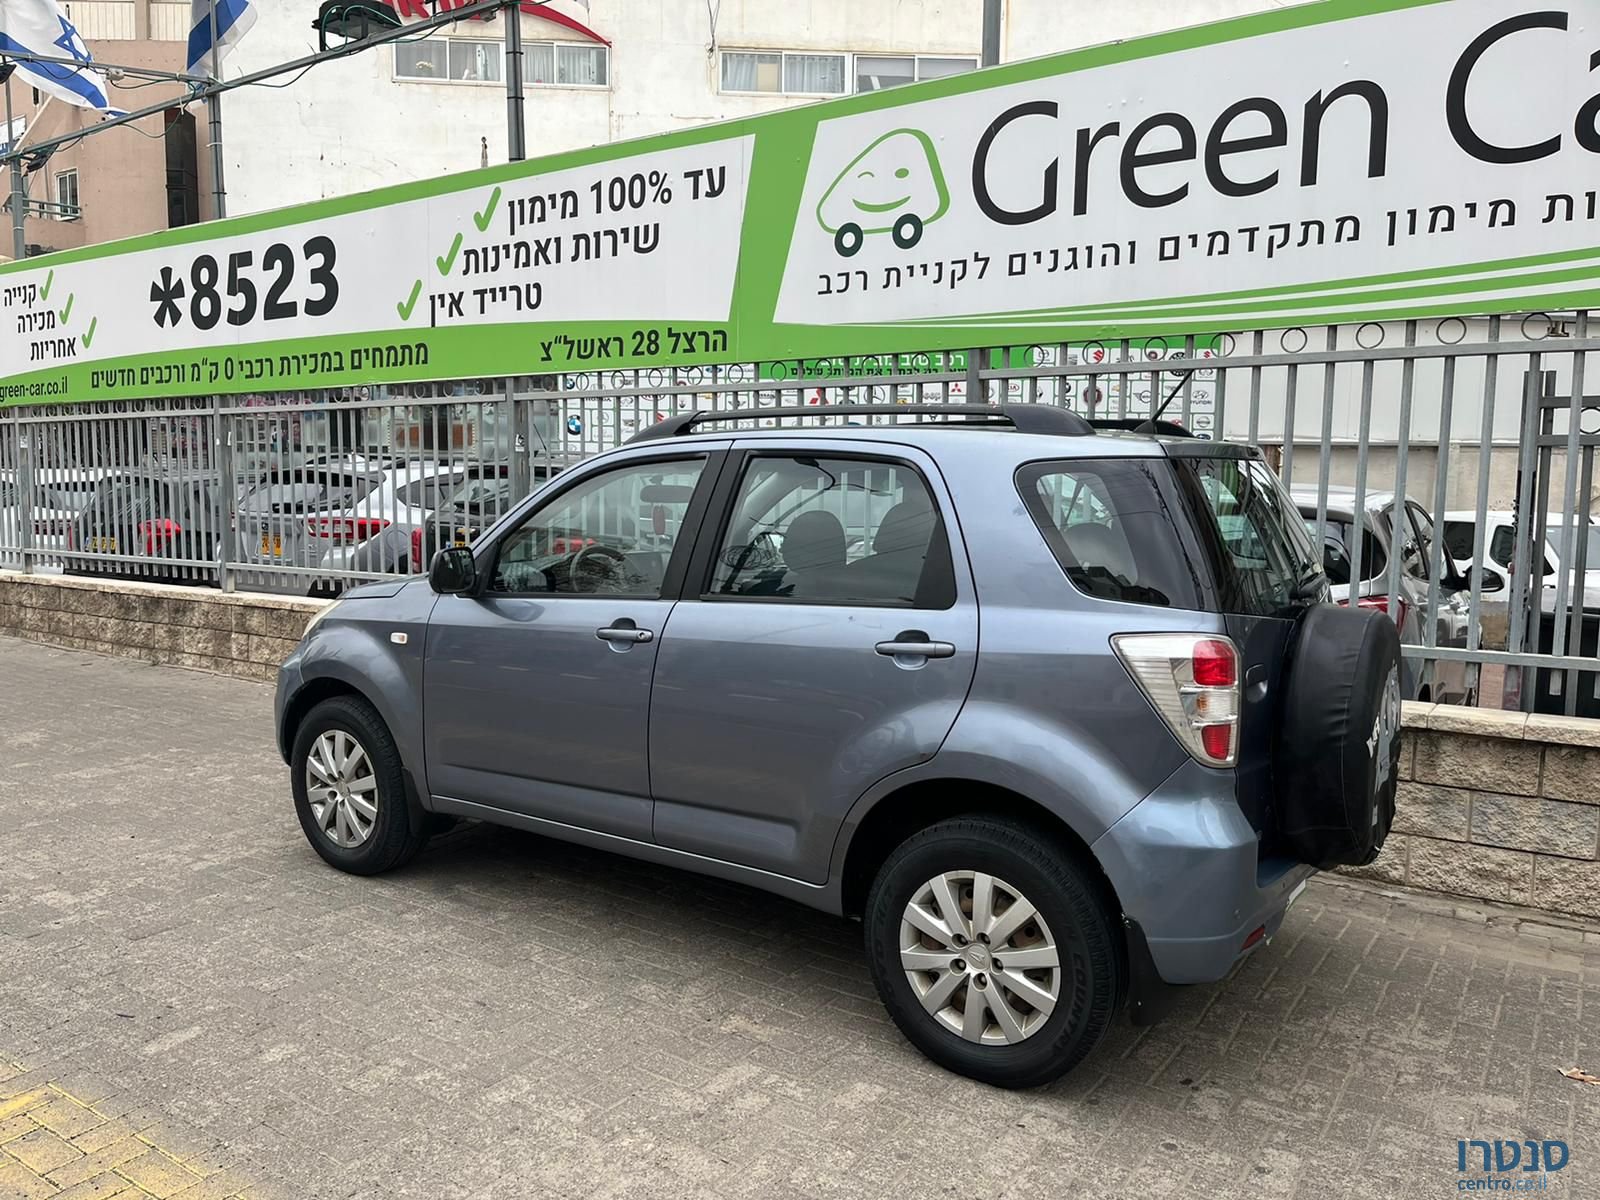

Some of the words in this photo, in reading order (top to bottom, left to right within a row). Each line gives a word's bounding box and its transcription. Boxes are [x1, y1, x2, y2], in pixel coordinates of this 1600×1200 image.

[973, 80, 1390, 226] Green
[591, 171, 671, 213] 100%
[684, 166, 725, 199] עד
[508, 190, 578, 236] מימון
[1387, 200, 1515, 246] מימון
[571, 223, 659, 261] שירות
[1159, 216, 1359, 261] מתקדמים
[463, 234, 561, 275] ואמינות
[1009, 241, 1135, 276] והוגנים
[818, 271, 867, 294] רכב
[883, 252, 989, 289] לקניית
[5, 284, 35, 308] קנייה
[430, 292, 464, 327] אין
[473, 283, 541, 314] טרייד
[18, 311, 55, 333] מכירה
[31, 338, 76, 360] אחריות
[632, 330, 659, 356] 28
[668, 328, 727, 353] הרצל
[225, 359, 233, 380] 0
[239, 358, 273, 379] רכבי
[279, 352, 344, 376] במכירת
[351, 343, 428, 369] מתמחים
[92, 369, 135, 388] חדשים
[141, 365, 185, 384] ורכבים
[0, 375, 68, 402] green-car.co.il
